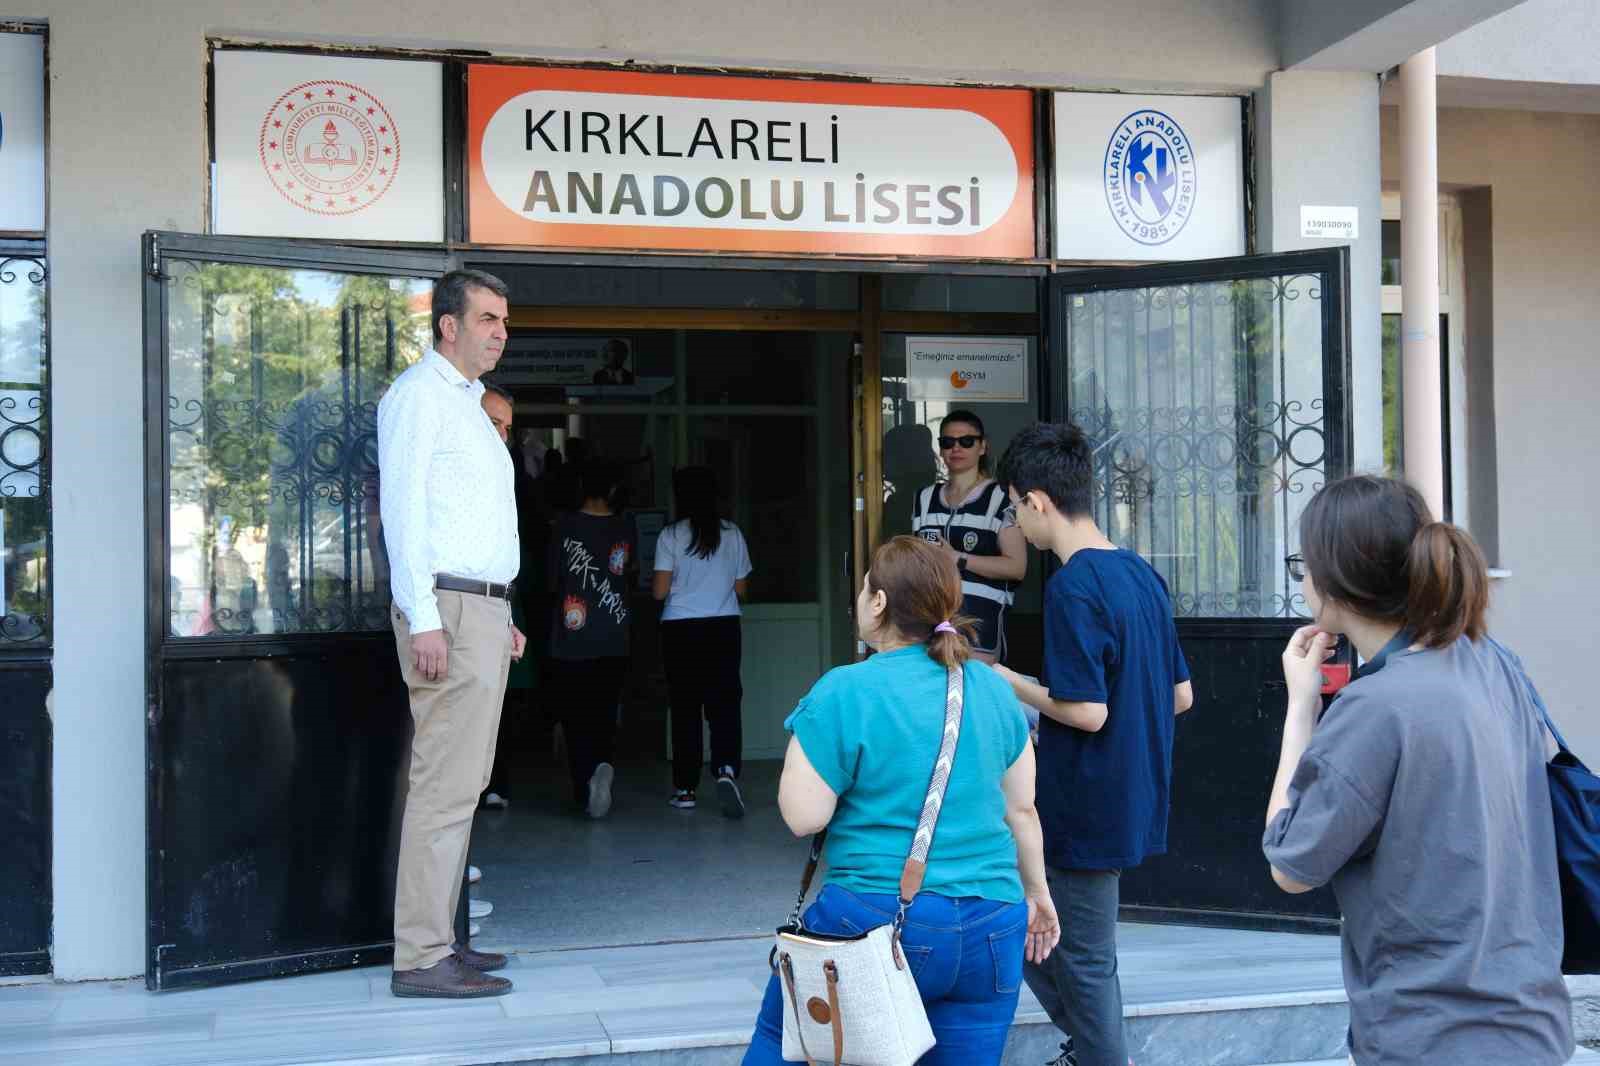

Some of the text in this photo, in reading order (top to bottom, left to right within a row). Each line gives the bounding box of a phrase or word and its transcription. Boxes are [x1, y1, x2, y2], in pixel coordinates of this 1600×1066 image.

[524, 109, 839, 164] KIRKLARELİ
[1135, 117, 1190, 164] ANADOLU
[522, 170, 980, 226] ANADOLU LİSESİ
[1132, 222, 1169, 239] 1985
